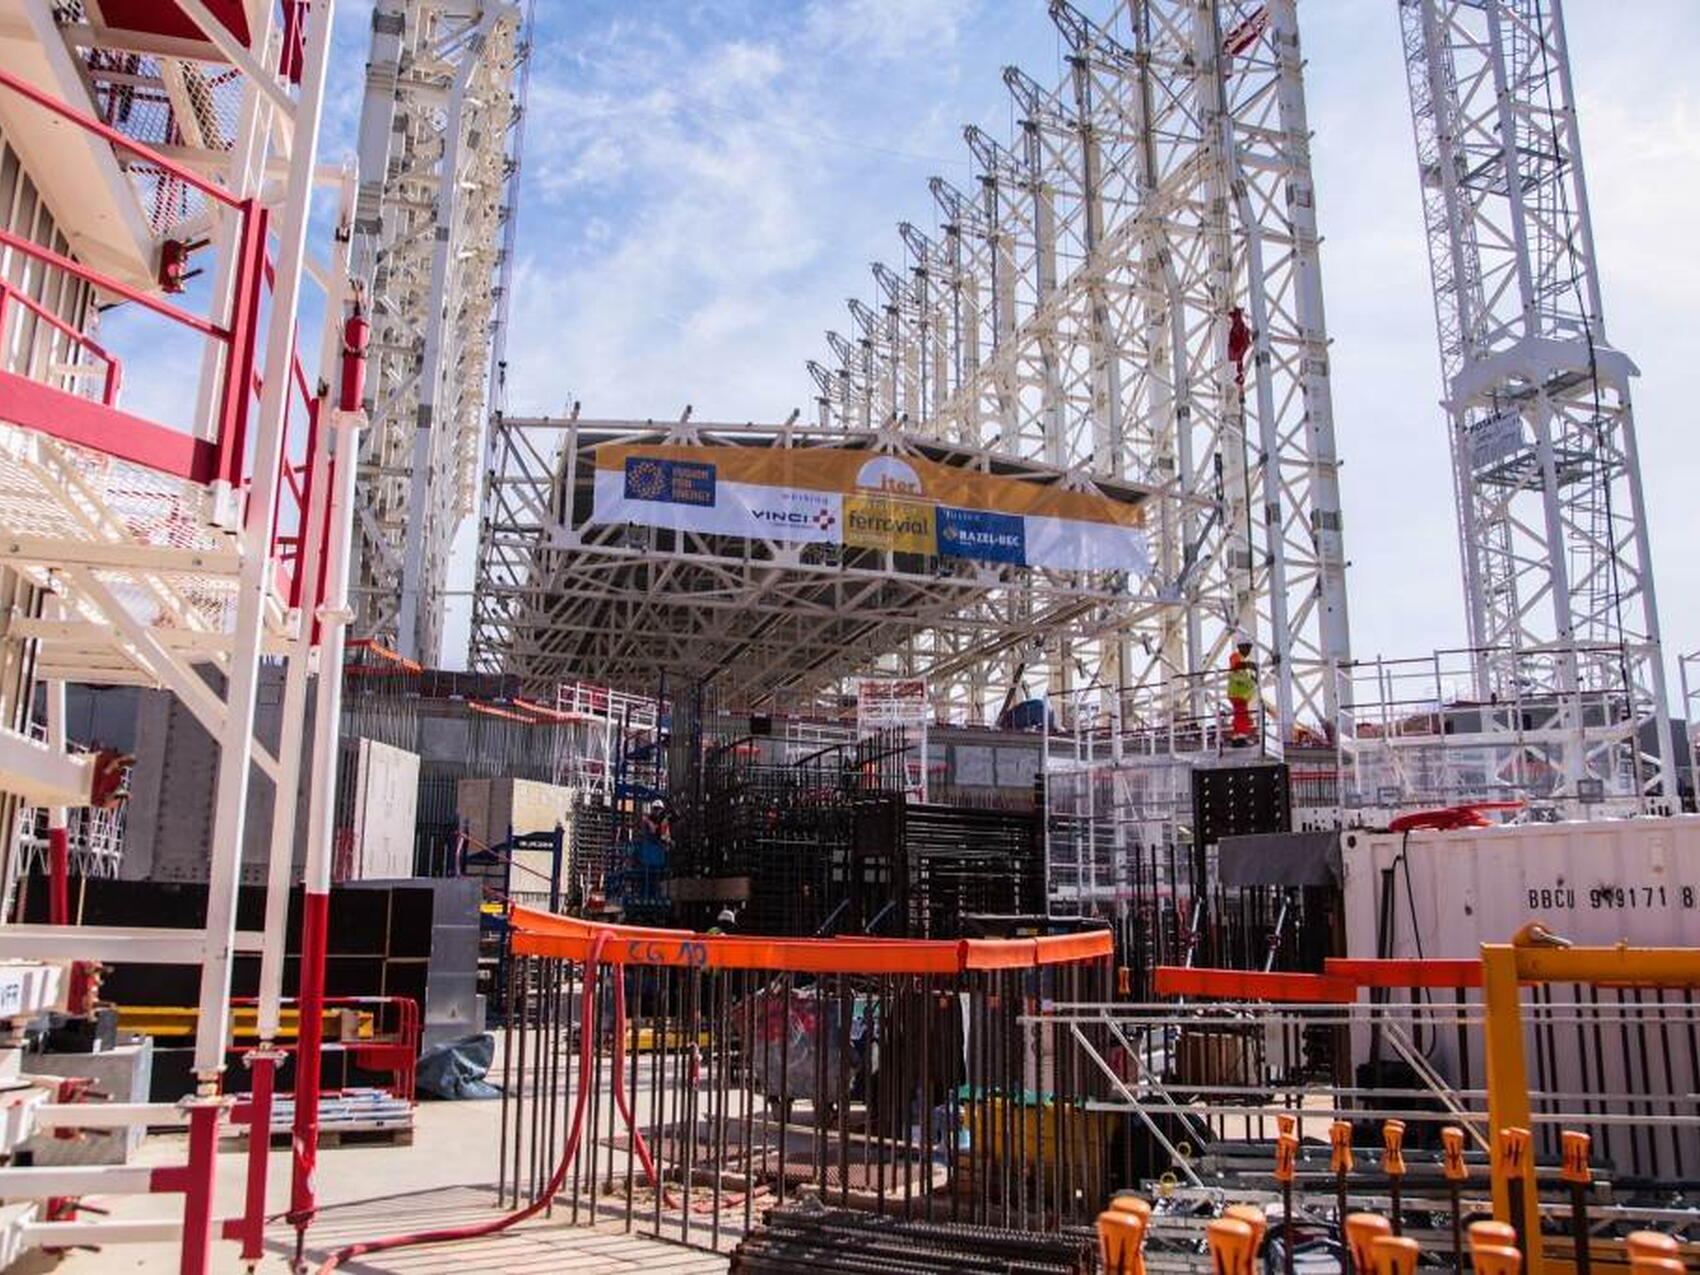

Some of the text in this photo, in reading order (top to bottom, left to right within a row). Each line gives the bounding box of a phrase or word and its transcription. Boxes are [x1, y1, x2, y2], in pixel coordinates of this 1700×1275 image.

[752, 509, 808, 523] VINCI
[849, 510, 928, 535] ferrovial
[1528, 889, 1575, 909] BBCU
[1682, 885, 1694, 908] 8
